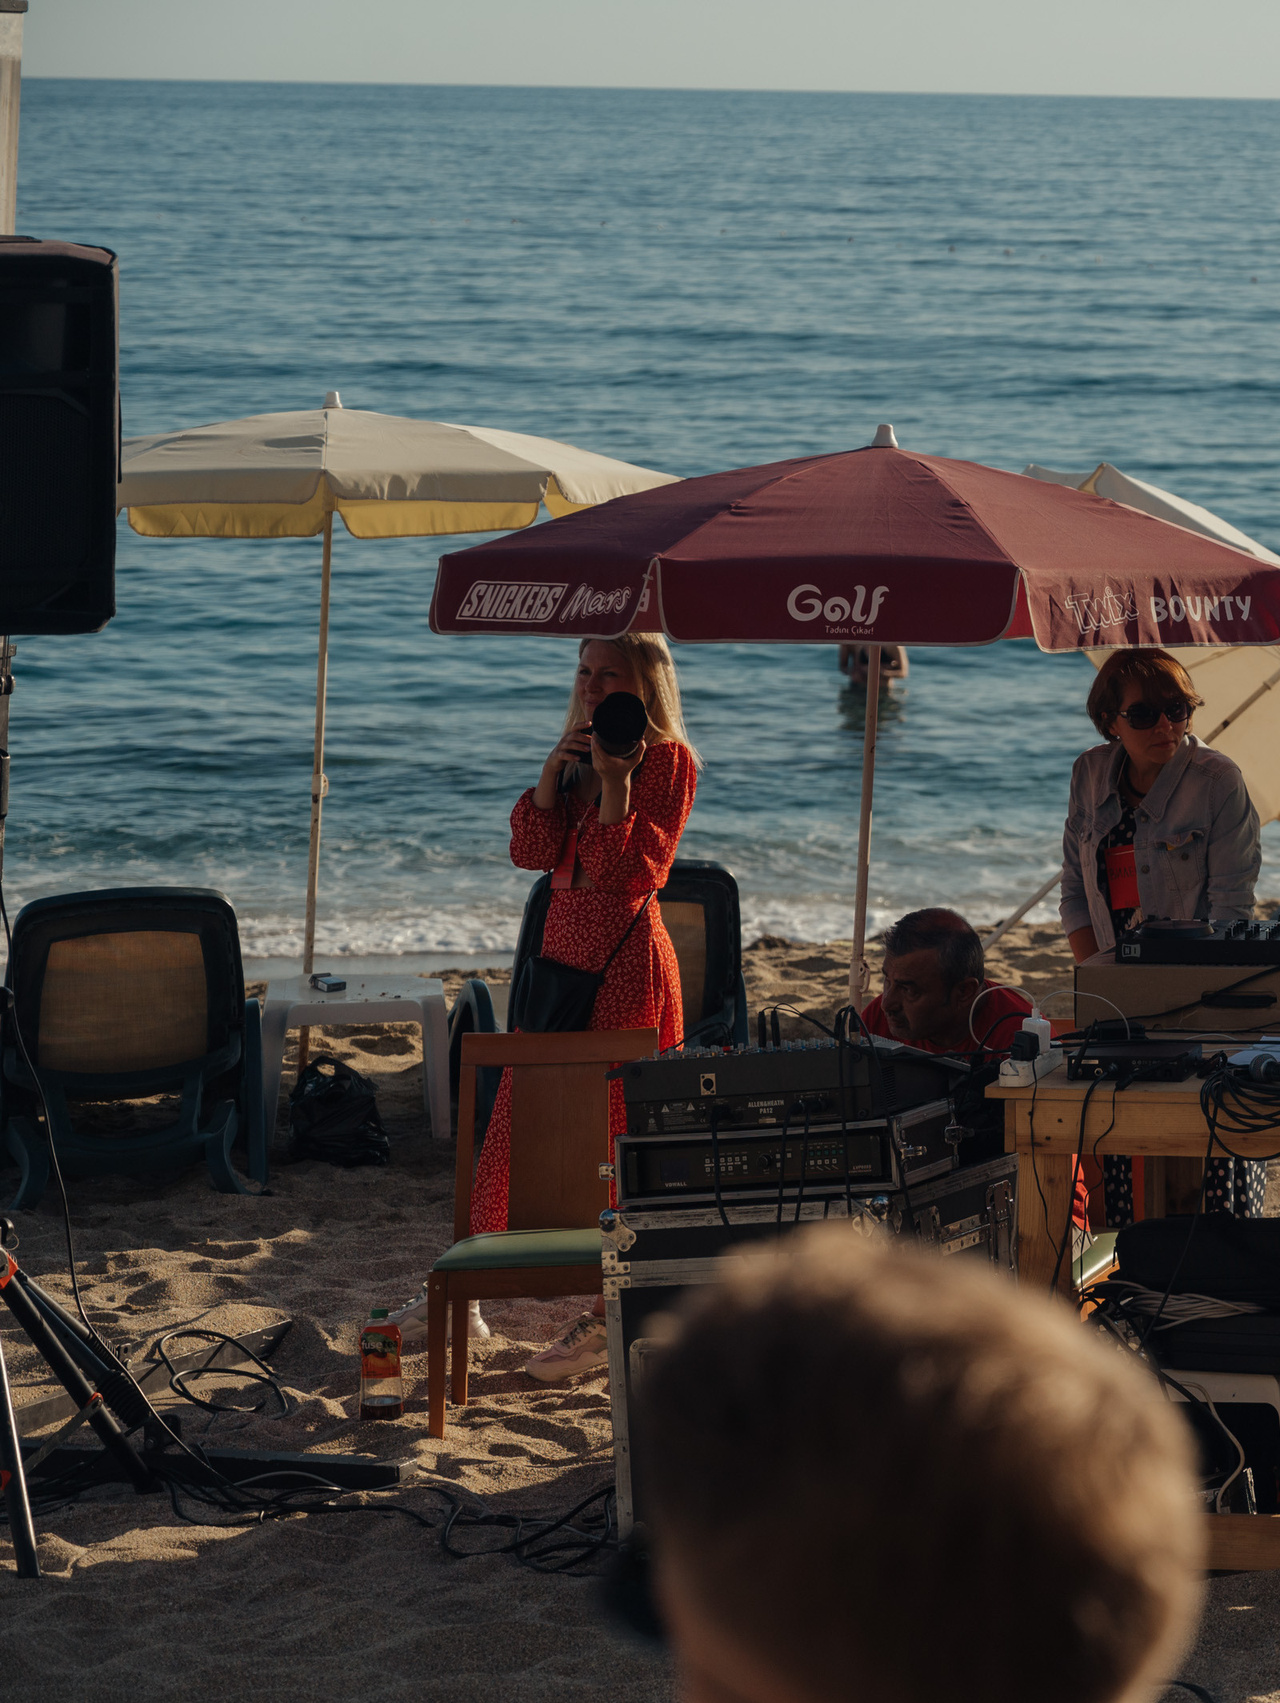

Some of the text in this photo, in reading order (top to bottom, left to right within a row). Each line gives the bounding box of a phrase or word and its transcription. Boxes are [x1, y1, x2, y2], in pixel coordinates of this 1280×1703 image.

[460, 583, 632, 622] SNICKERS Mars
[787, 584, 889, 625] Golf
[1150, 595, 1251, 622] BOUNTY
